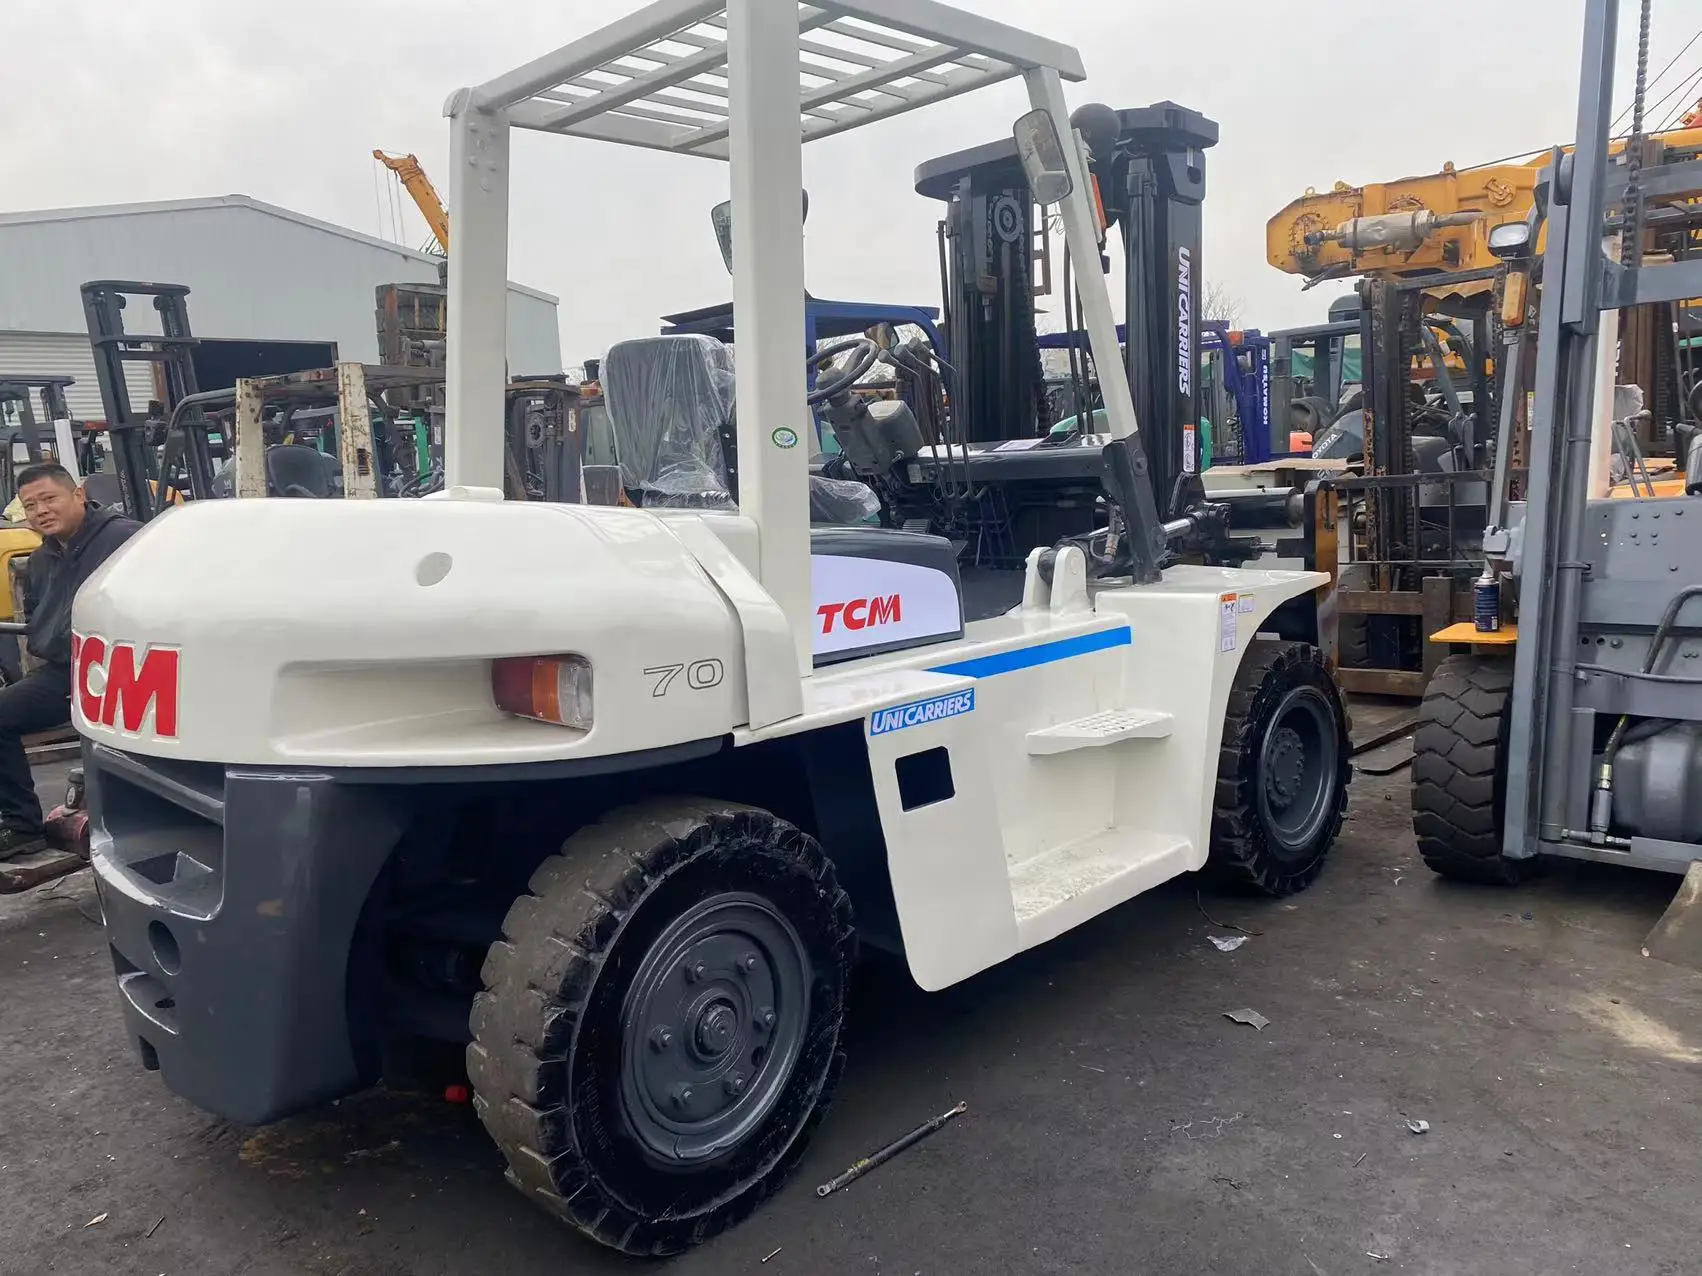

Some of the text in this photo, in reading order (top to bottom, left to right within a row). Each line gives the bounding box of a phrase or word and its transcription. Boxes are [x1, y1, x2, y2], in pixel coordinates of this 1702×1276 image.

[1179, 246, 1190, 397] UNICARRIERS
[1311, 433, 1338, 459] OYOTA
[817, 593, 901, 634] TCM
[643, 658, 724, 697] 70
[872, 689, 973, 734] UNICARRIERS
